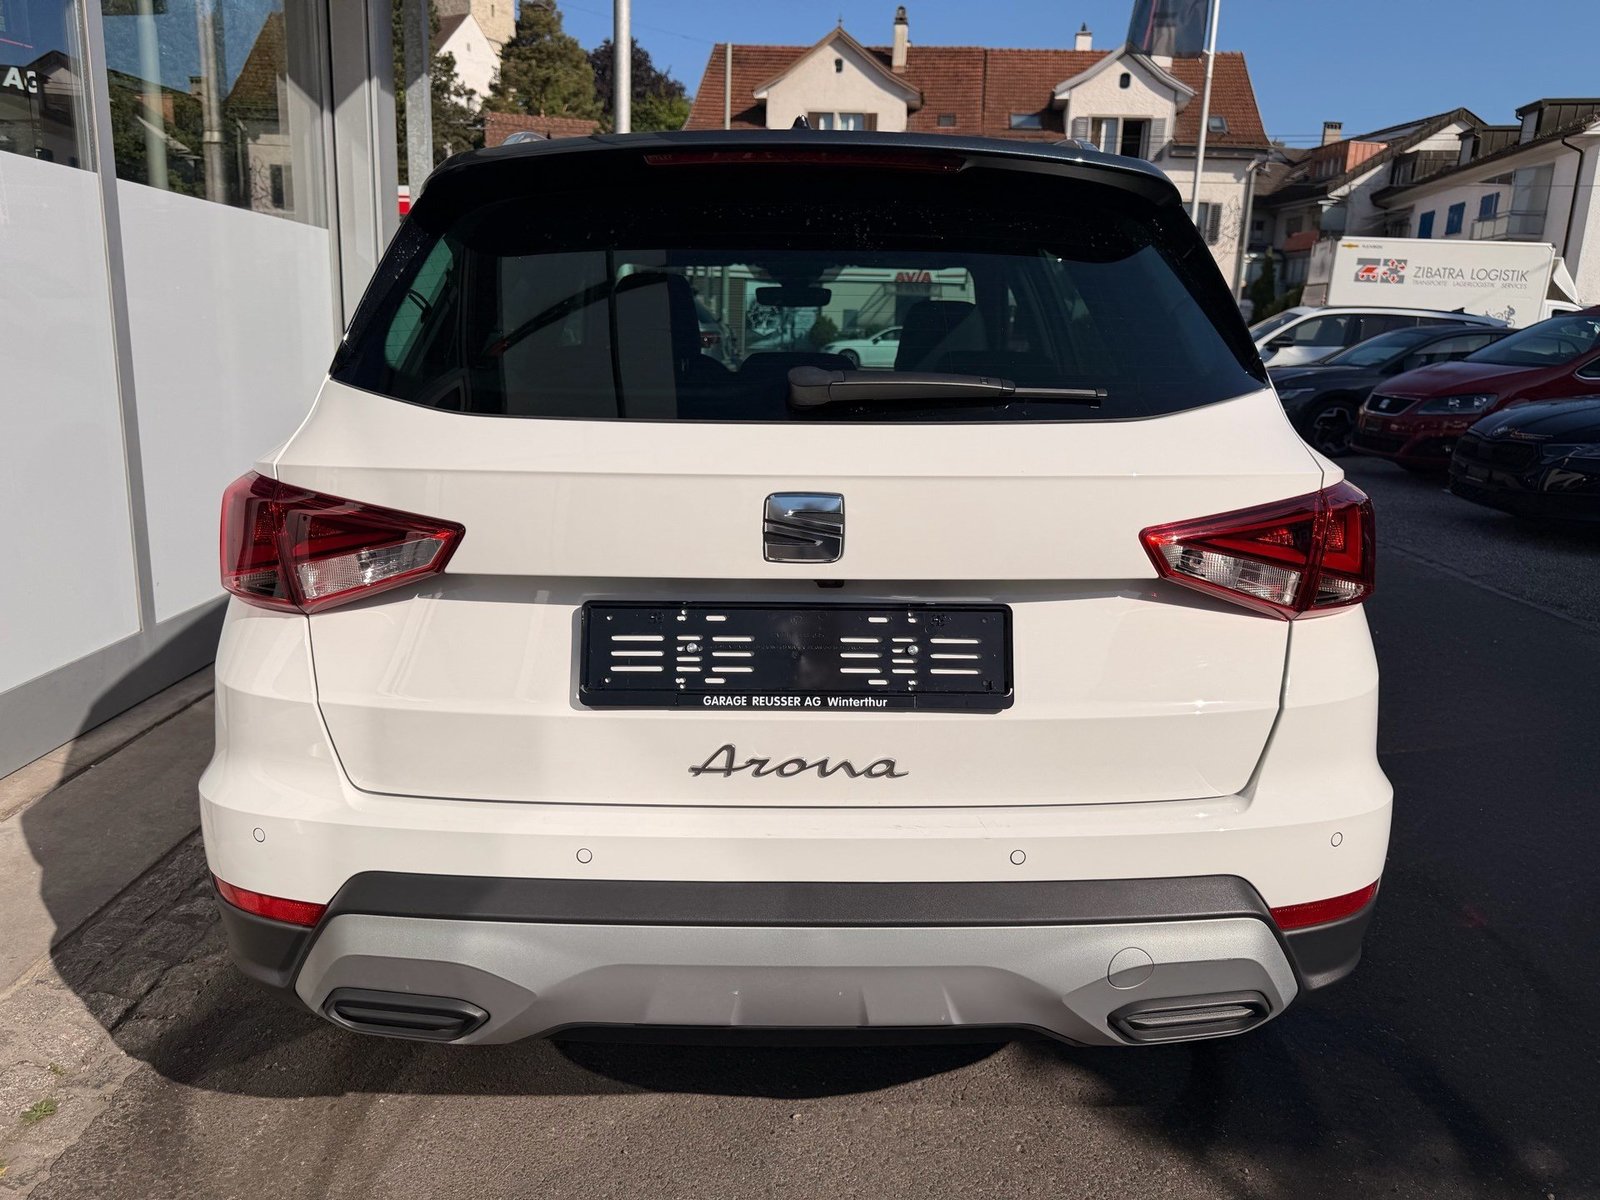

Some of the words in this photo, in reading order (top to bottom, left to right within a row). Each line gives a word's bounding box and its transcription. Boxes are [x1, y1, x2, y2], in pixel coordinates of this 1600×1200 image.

[1413, 266, 1465, 280] ZIBATRA
[1470, 268, 1530, 282] LOGISTIK
[703, 695, 747, 706] GARAGE
[752, 695, 801, 707] REUSSER
[804, 696, 822, 707] AG
[827, 697, 888, 708] Winterthur
[688, 743, 910, 778] Arona
